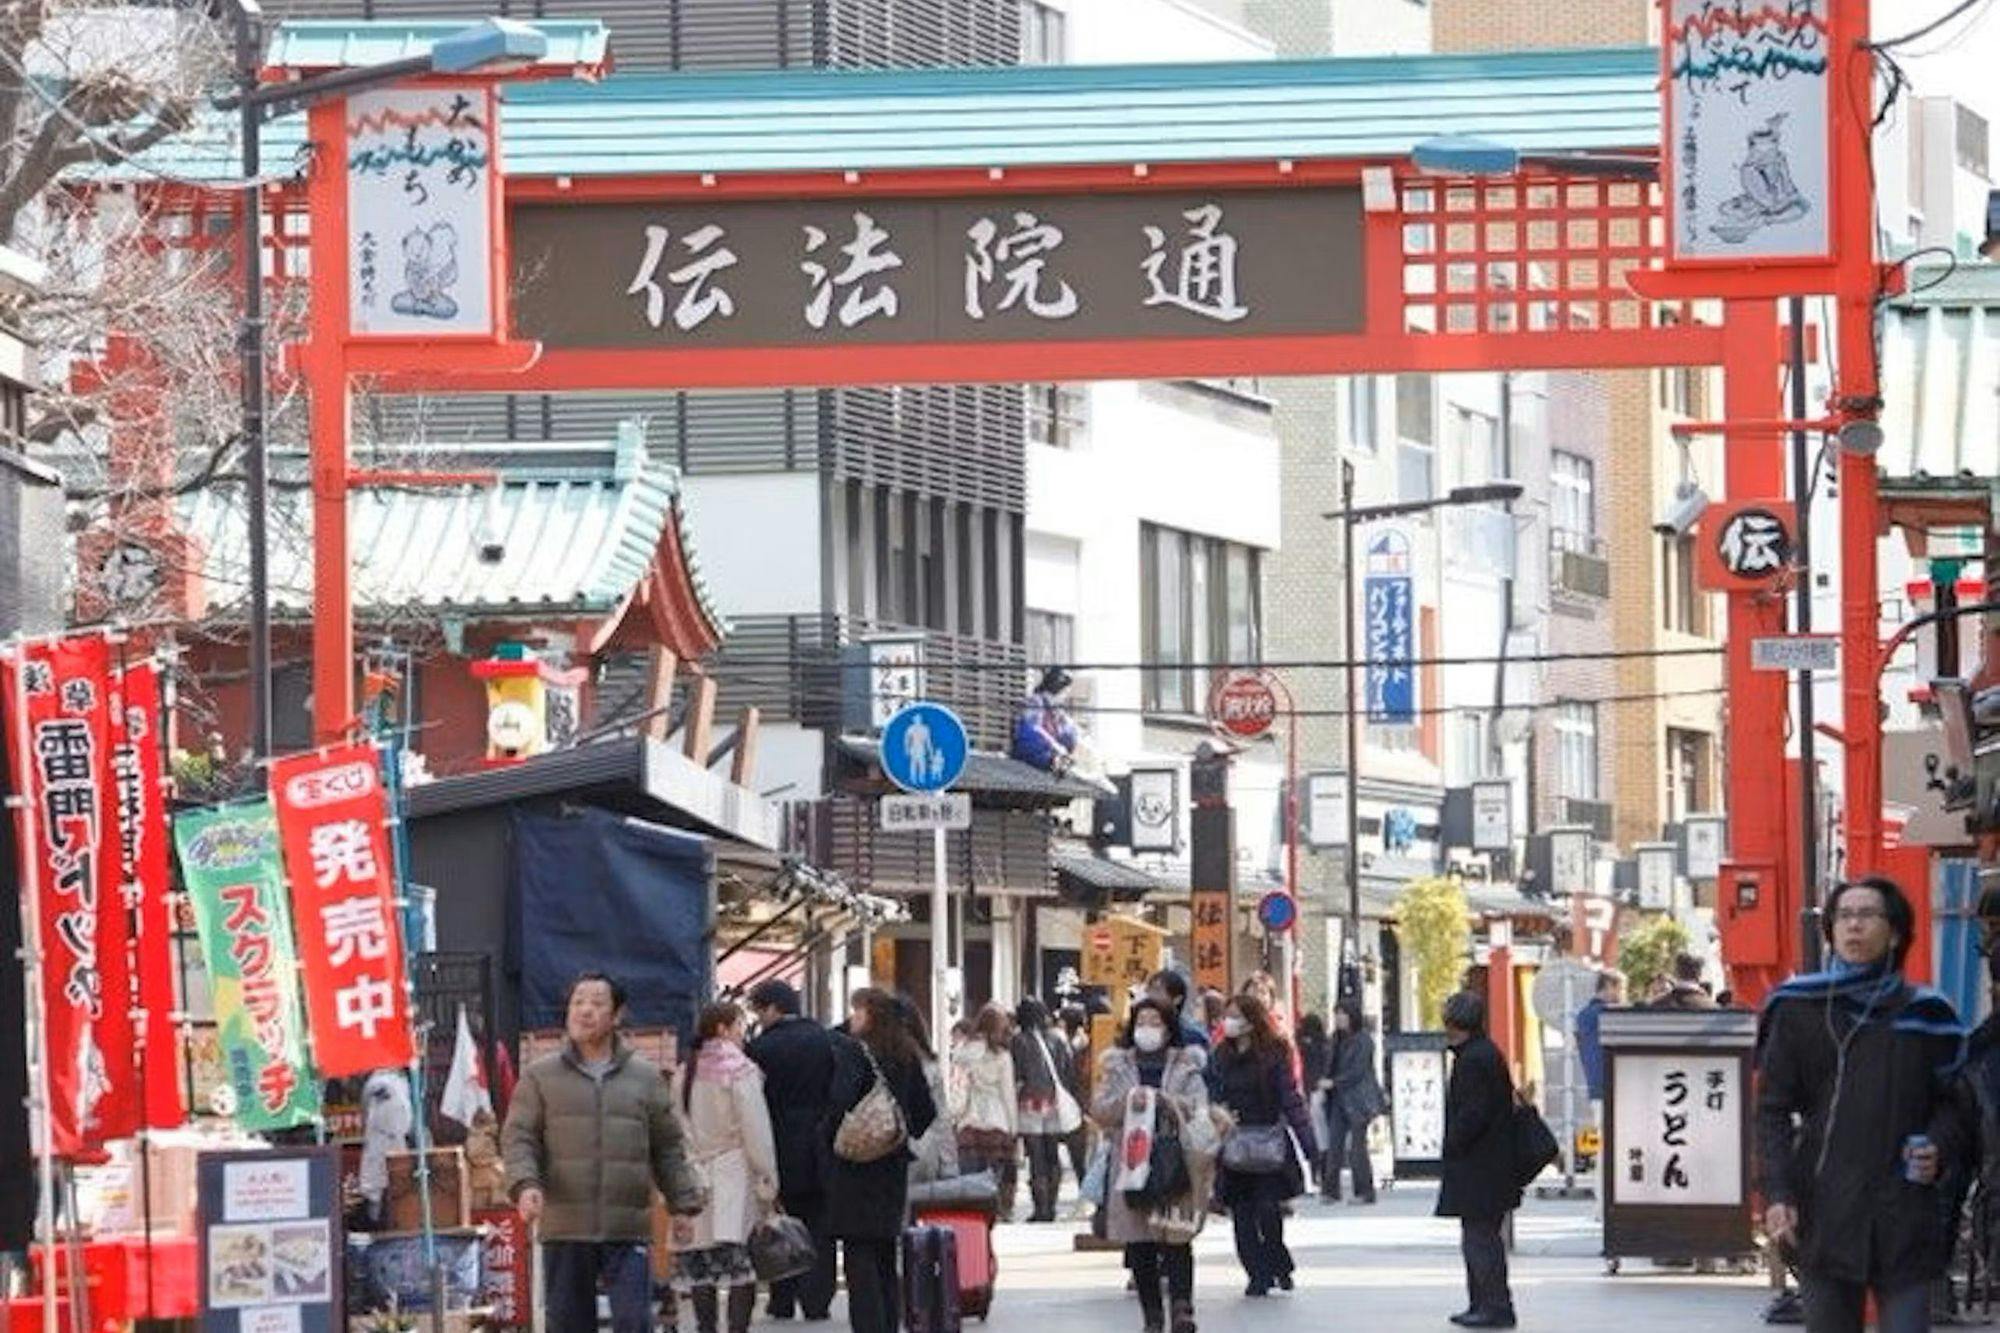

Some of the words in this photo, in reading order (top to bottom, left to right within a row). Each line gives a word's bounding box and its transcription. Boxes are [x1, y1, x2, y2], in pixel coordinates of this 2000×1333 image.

[627, 204, 1248, 329] 伝法院通
[1719, 511, 1781, 574] 伝
[308, 819, 396, 1039] 発売中
[219, 884, 296, 1112] スクラッチ
[1663, 1071, 1688, 1188] うどん
